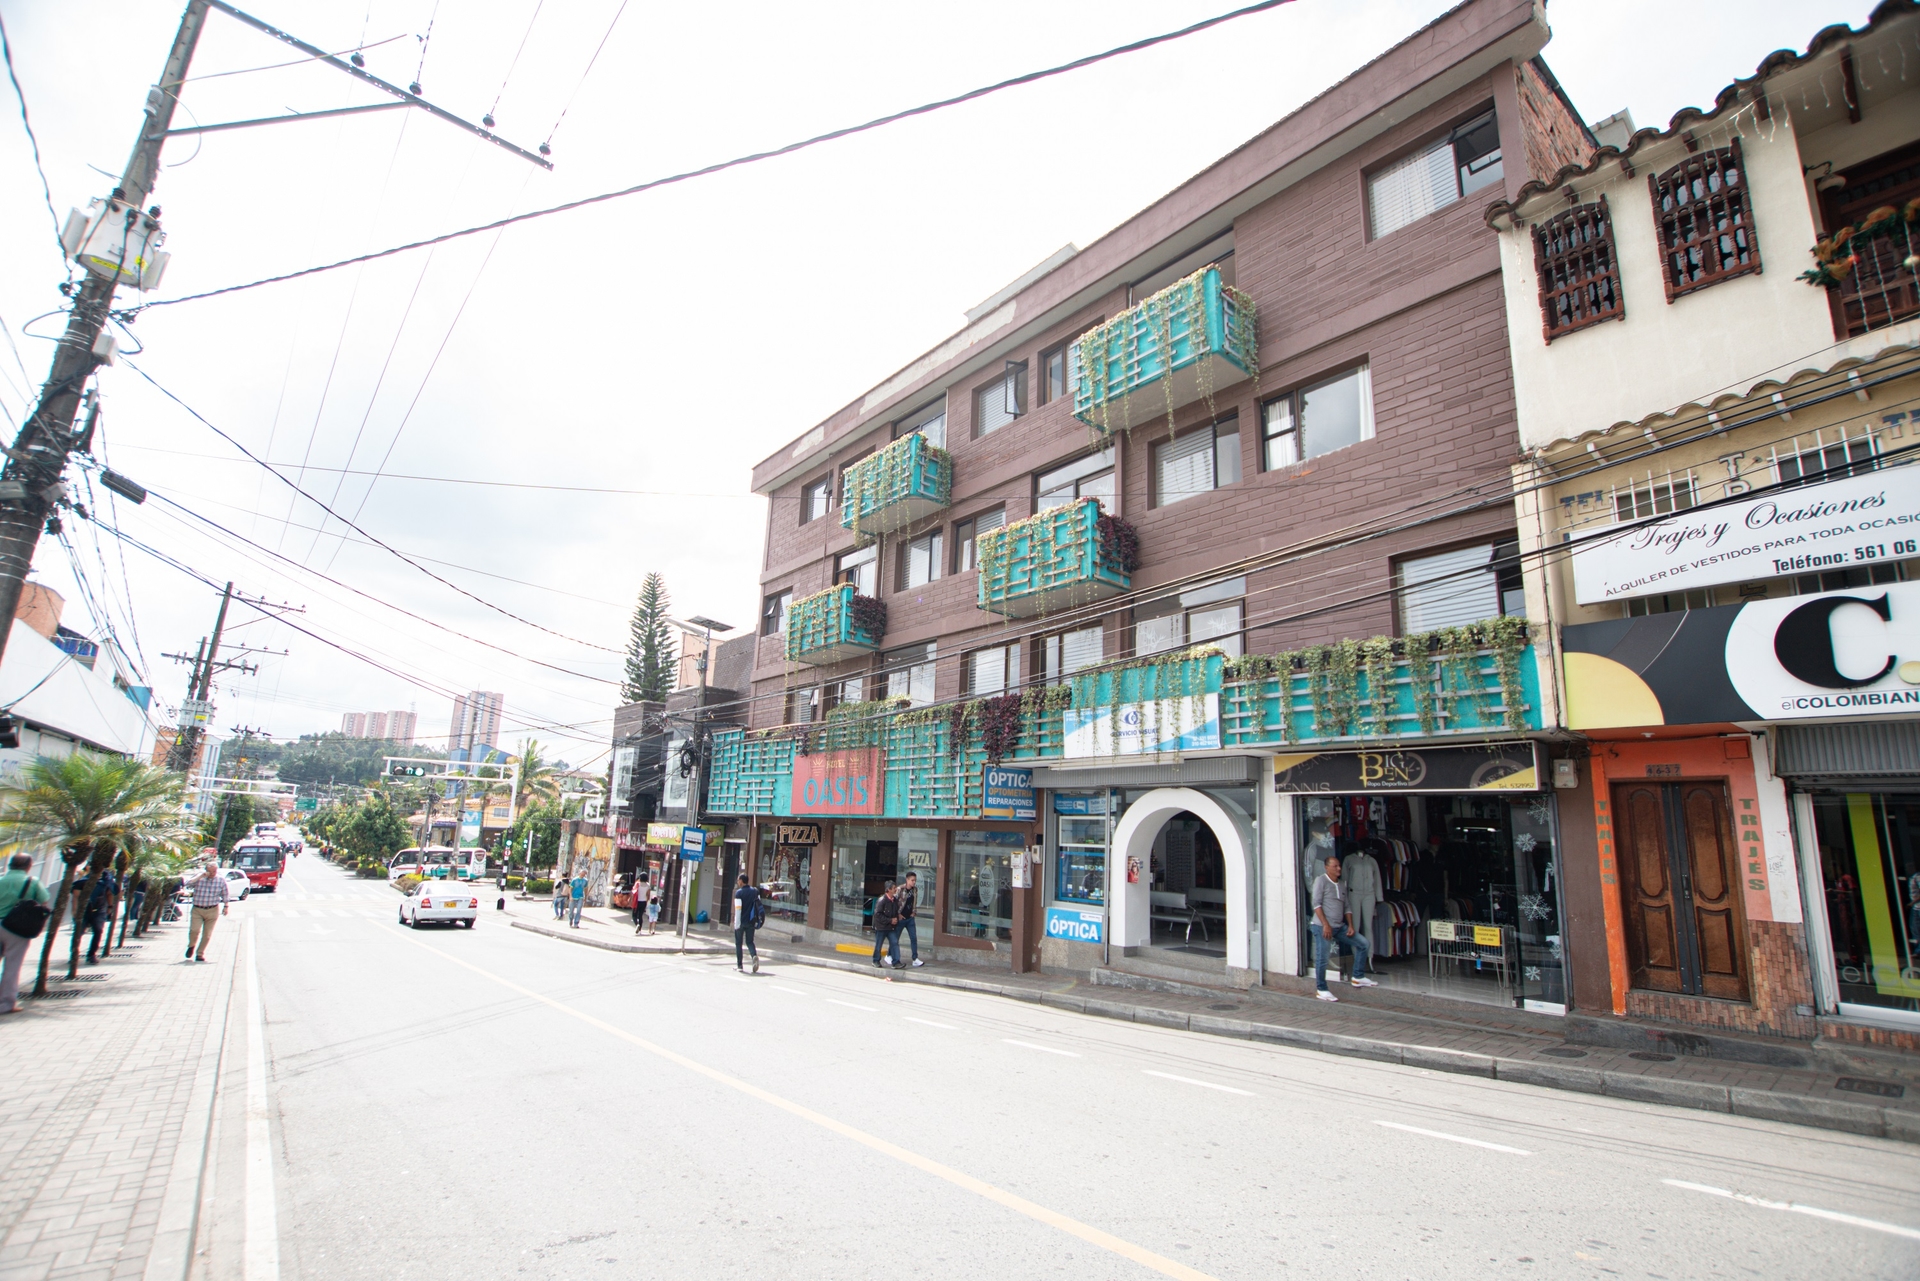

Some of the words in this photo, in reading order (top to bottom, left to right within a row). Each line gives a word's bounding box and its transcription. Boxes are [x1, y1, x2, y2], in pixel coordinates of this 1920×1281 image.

[1631, 520, 1707, 555] Trajes
[1706, 522, 1731, 548] y
[1745, 491, 1886, 529] Ocasiones
[1605, 571, 1668, 597] ALQUILER
[1670, 564, 1689, 576] DE
[1691, 545, 1761, 568] VESTIDOS
[1764, 535, 1807, 551] PARA
[1809, 525, 1856, 540] TODA
[1772, 552, 1849, 574] Teléfono:
[1854, 544, 1886, 560] 561
[1894, 539, 1917, 555] 06
[803, 775, 868, 807] OASIS
[988, 768, 1034, 788] ÓPTICA
[1381, 780, 1408, 788] Deportiva
[988, 797, 1033, 807] REPARACIONES
[779, 825, 819, 843] PIZZA
[1597, 801, 1616, 884] TRAJES
[1738, 798, 1766, 891] TRAJES
[908, 852, 930, 867] PIZZA
[1050, 915, 1099, 940] ÓPTICA
